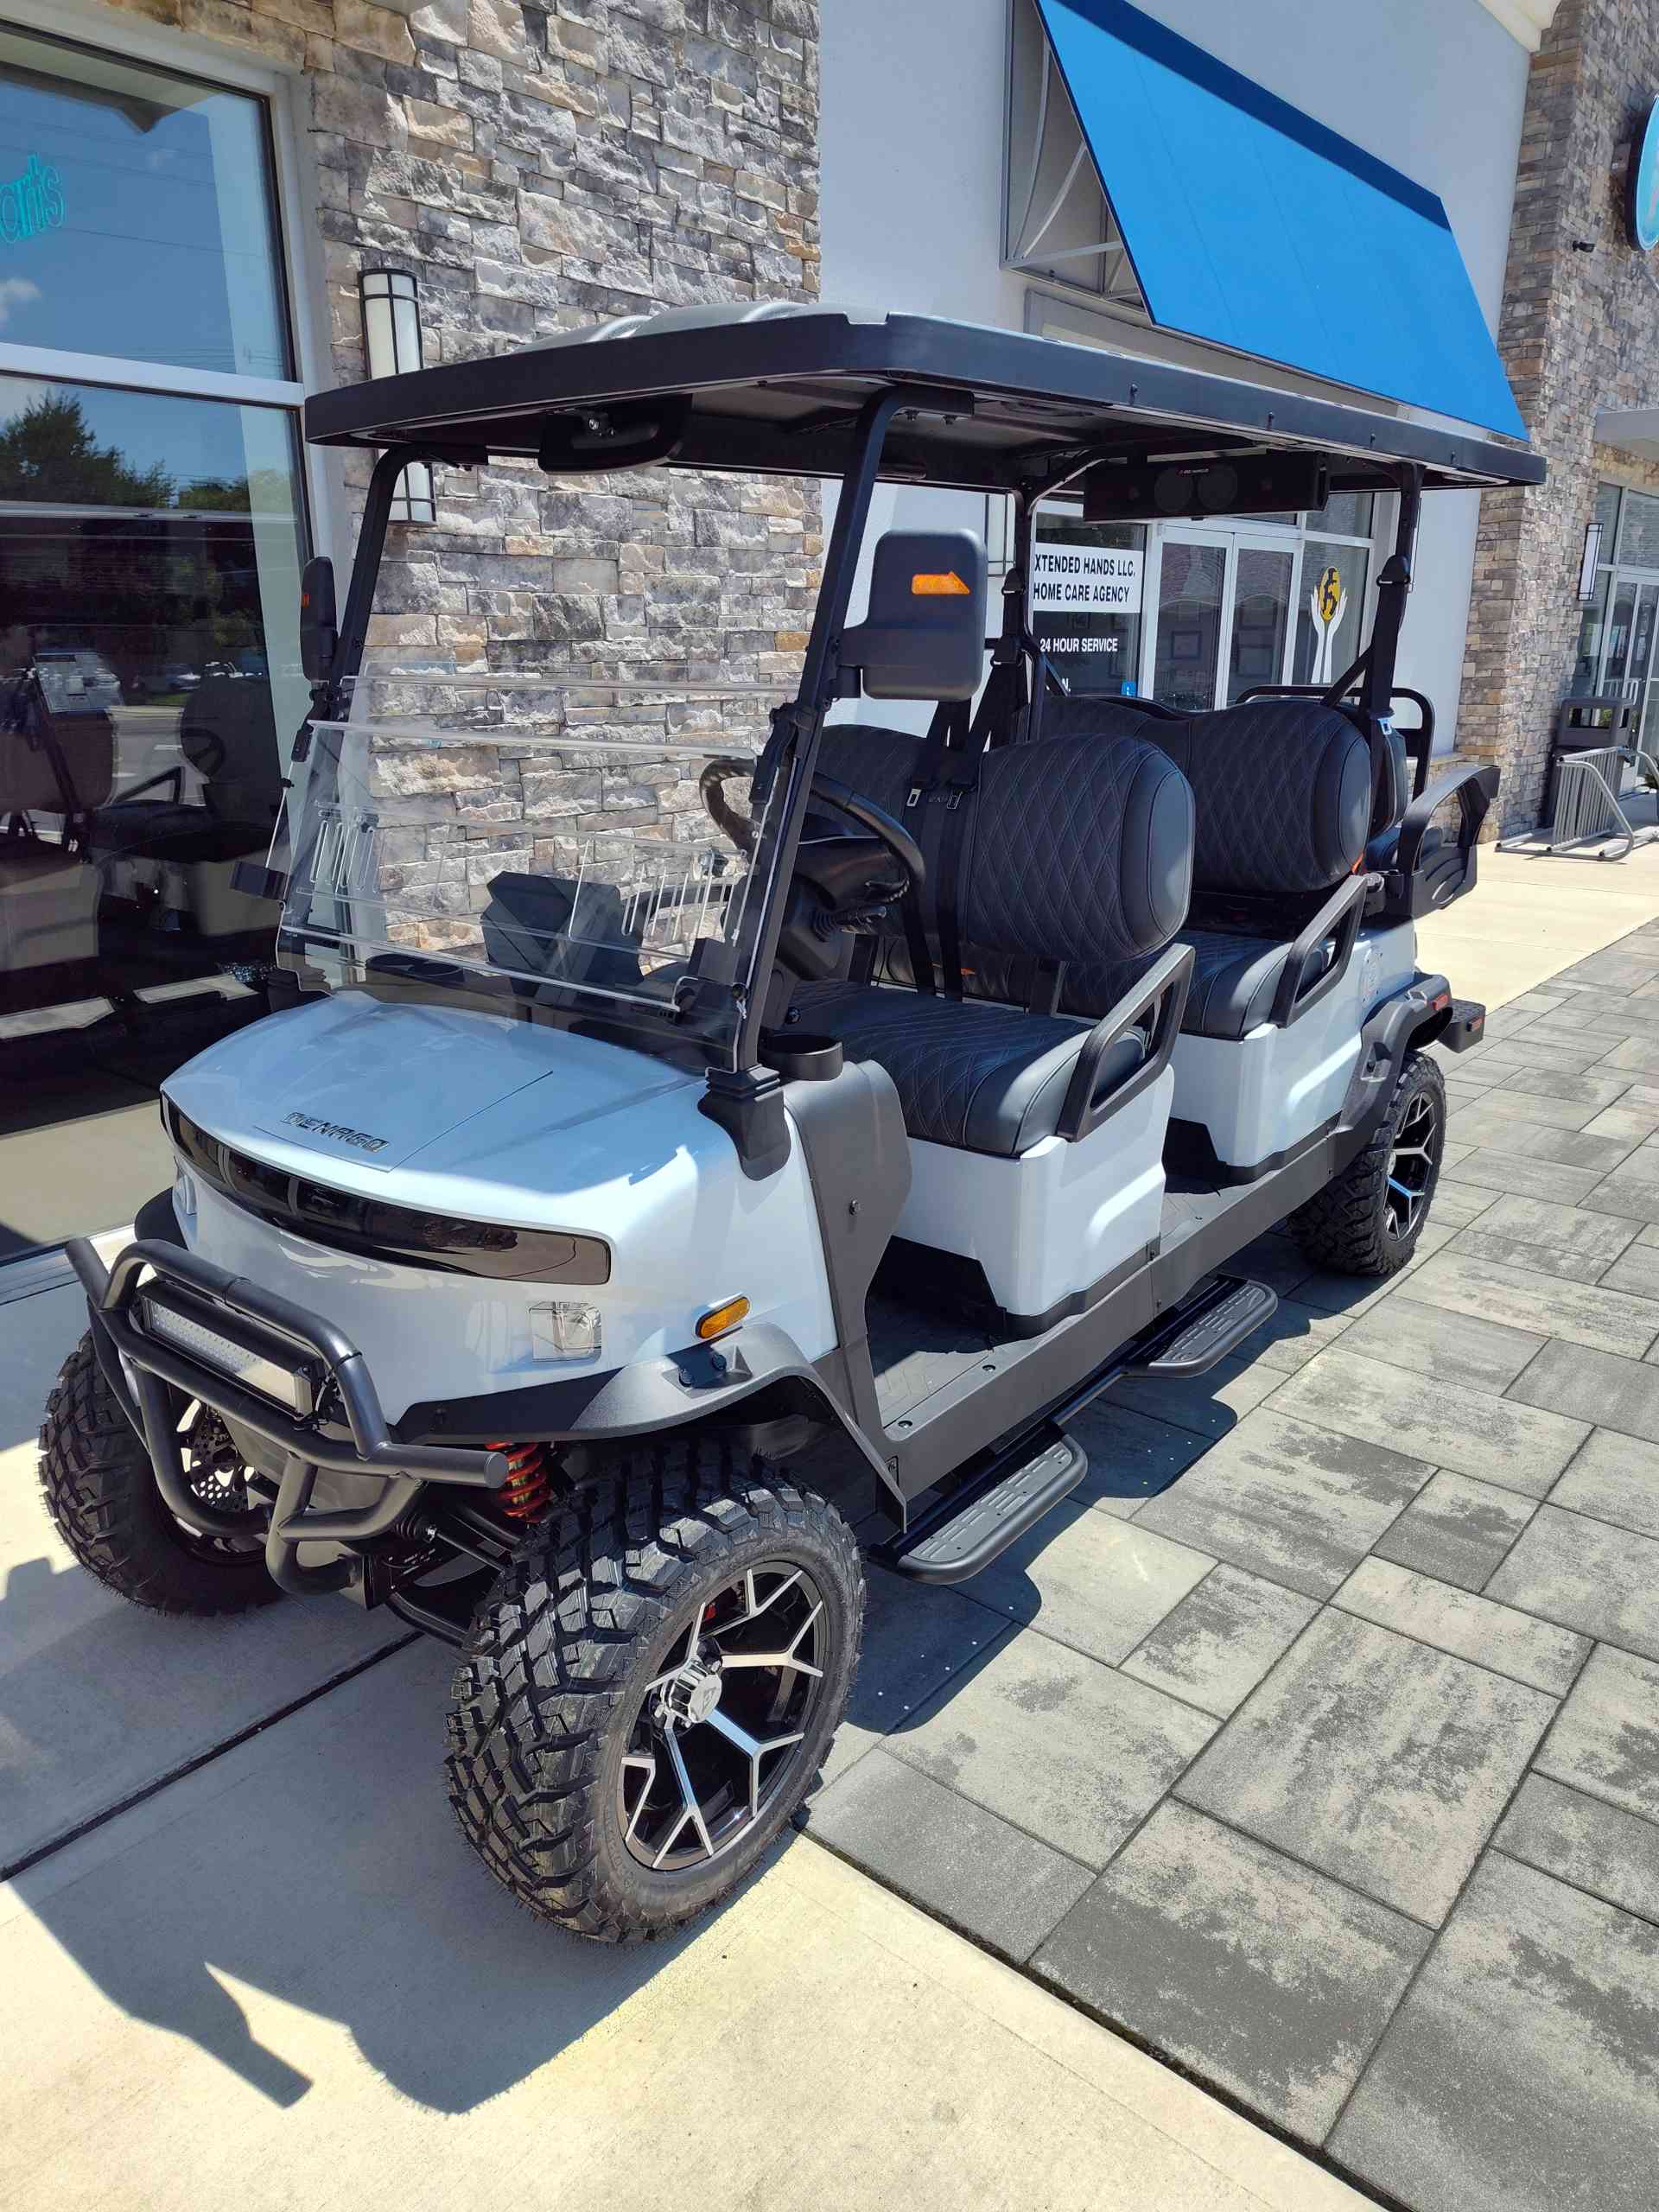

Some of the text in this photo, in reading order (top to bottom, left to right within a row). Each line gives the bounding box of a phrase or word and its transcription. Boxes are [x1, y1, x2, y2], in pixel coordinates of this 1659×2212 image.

[1034, 554, 1136, 577] XTENDED HANDS LLC.
[1033, 582, 1130, 603] HOME CARE AGENCY
[1039, 638, 1118, 652] 24 HOUR SERVICE
[280, 1111, 390, 1153] DENAGO
